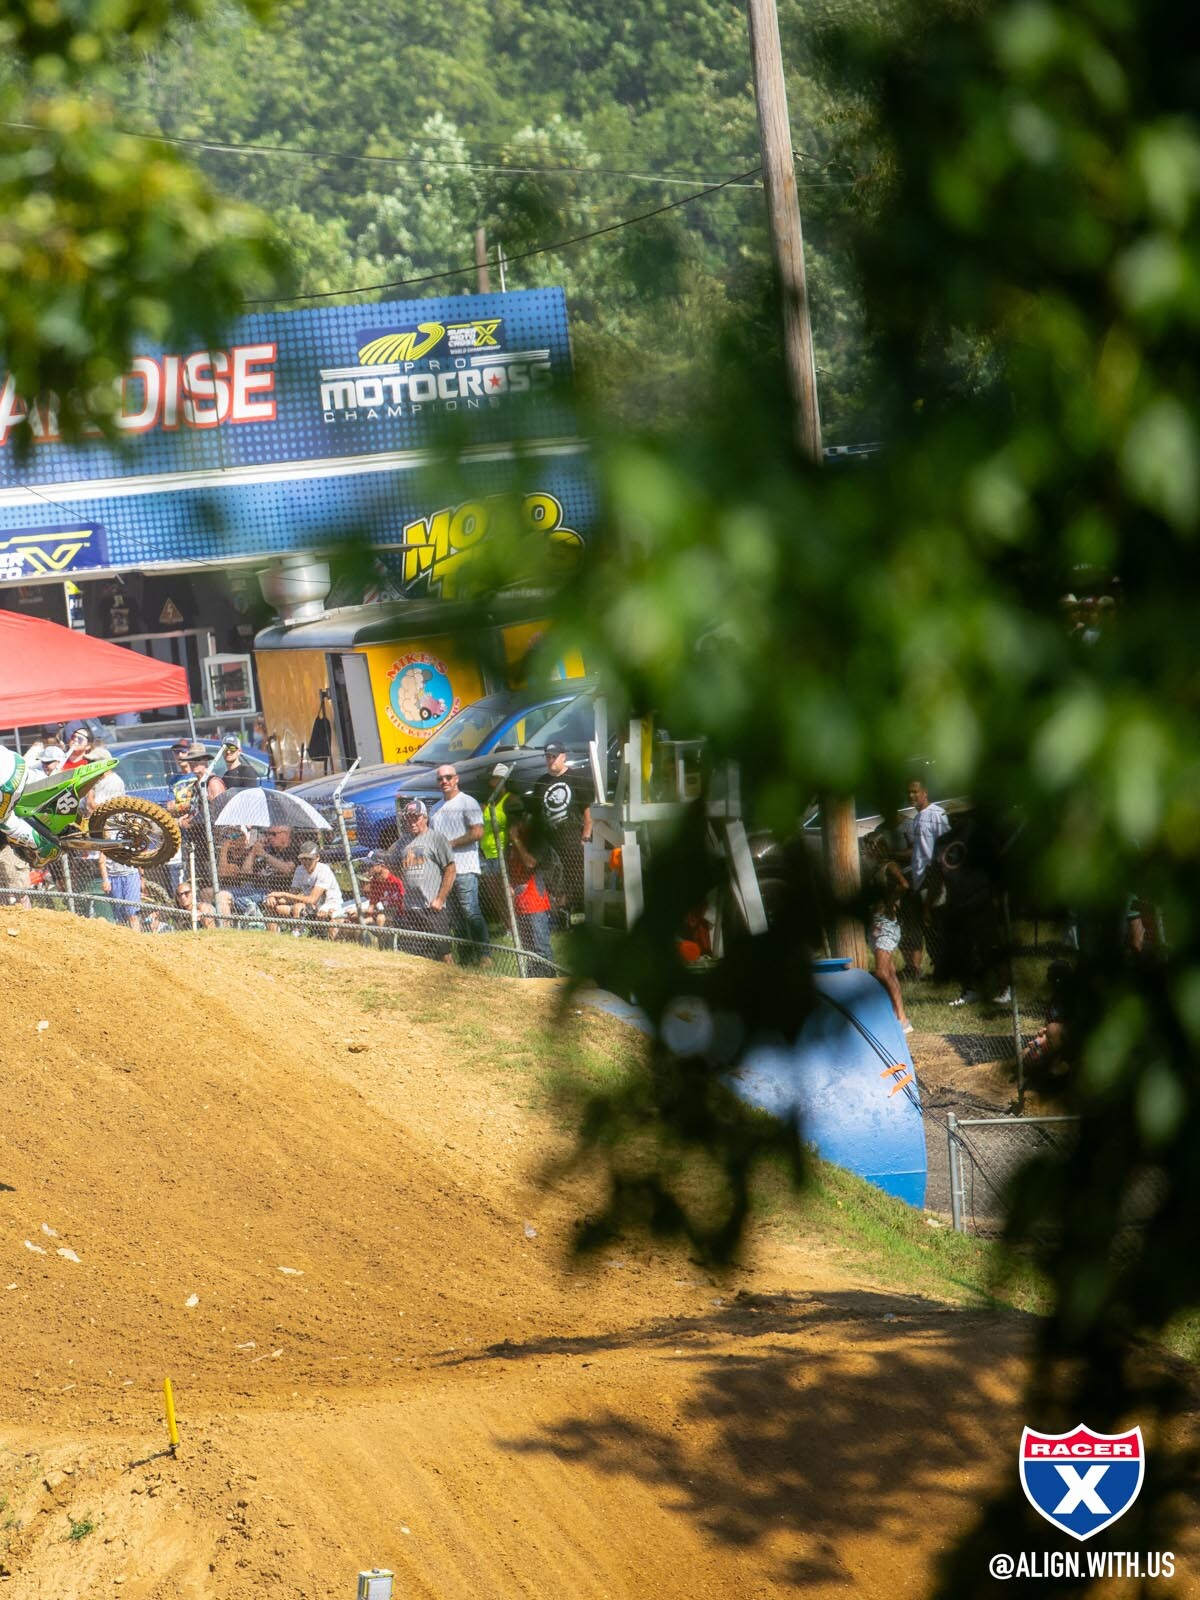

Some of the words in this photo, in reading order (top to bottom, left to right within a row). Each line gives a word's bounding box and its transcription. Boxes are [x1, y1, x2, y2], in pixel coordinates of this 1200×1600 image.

[404, 357, 465, 373] PRO
[320, 361, 552, 411] MOTOCROSS
[402, 492, 564, 584] MOO
[56, 791, 79, 814] 55
